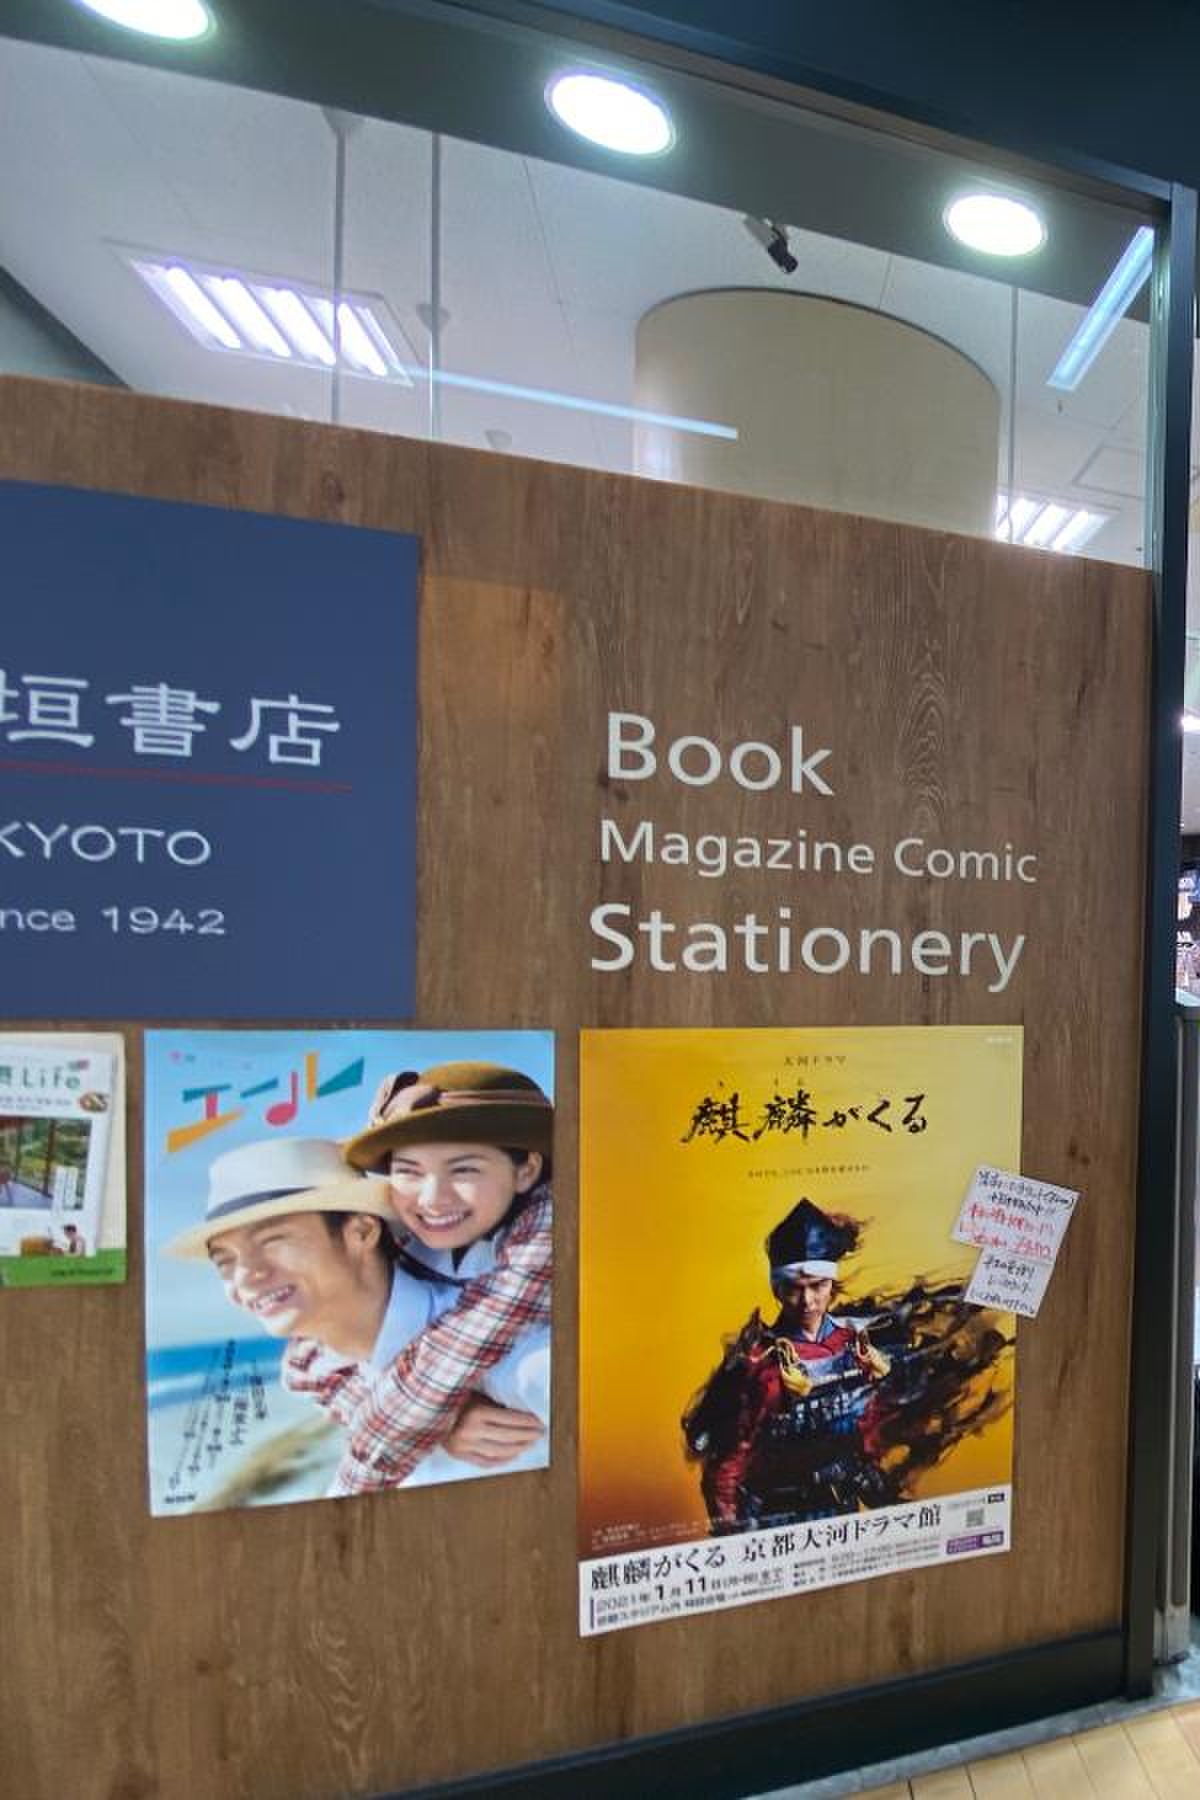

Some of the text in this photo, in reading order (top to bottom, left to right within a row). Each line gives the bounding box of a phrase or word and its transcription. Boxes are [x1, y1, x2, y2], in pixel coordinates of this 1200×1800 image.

[0, 669, 340, 766] 垣書店
[607, 711, 835, 796] Book
[601, 819, 1038, 883] Magazine Comic
[101, 906, 225, 935] 1942
[589, 903, 1026, 993] Stationery
[681, 1089, 928, 1144] 麒麟がくる
